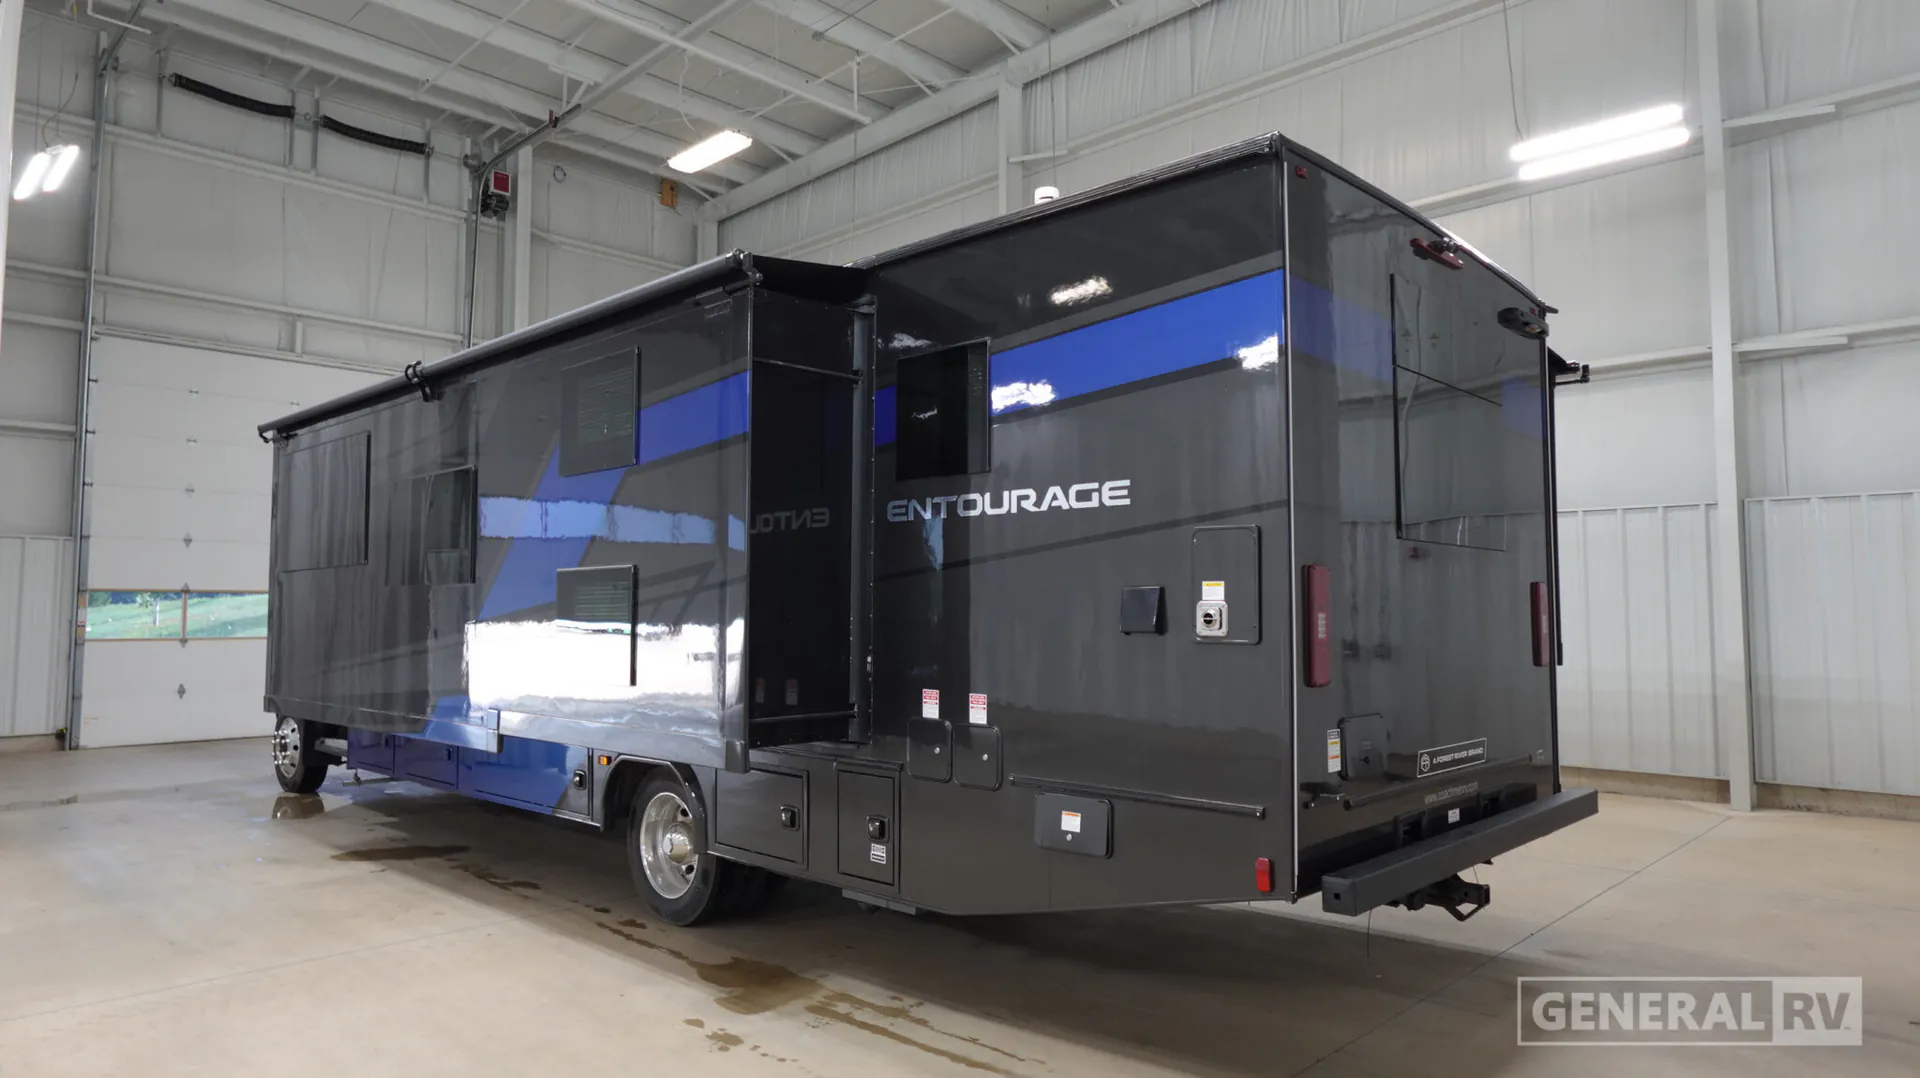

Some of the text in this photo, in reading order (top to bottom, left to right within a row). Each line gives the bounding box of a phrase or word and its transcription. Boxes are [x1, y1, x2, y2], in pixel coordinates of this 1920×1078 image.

[887, 479, 1131, 522] ENTOURAGE
[1437, 753, 1454, 763] FOREST
[1454, 750, 1468, 760] RIVER
[1468, 747, 1484, 757] BRAND
